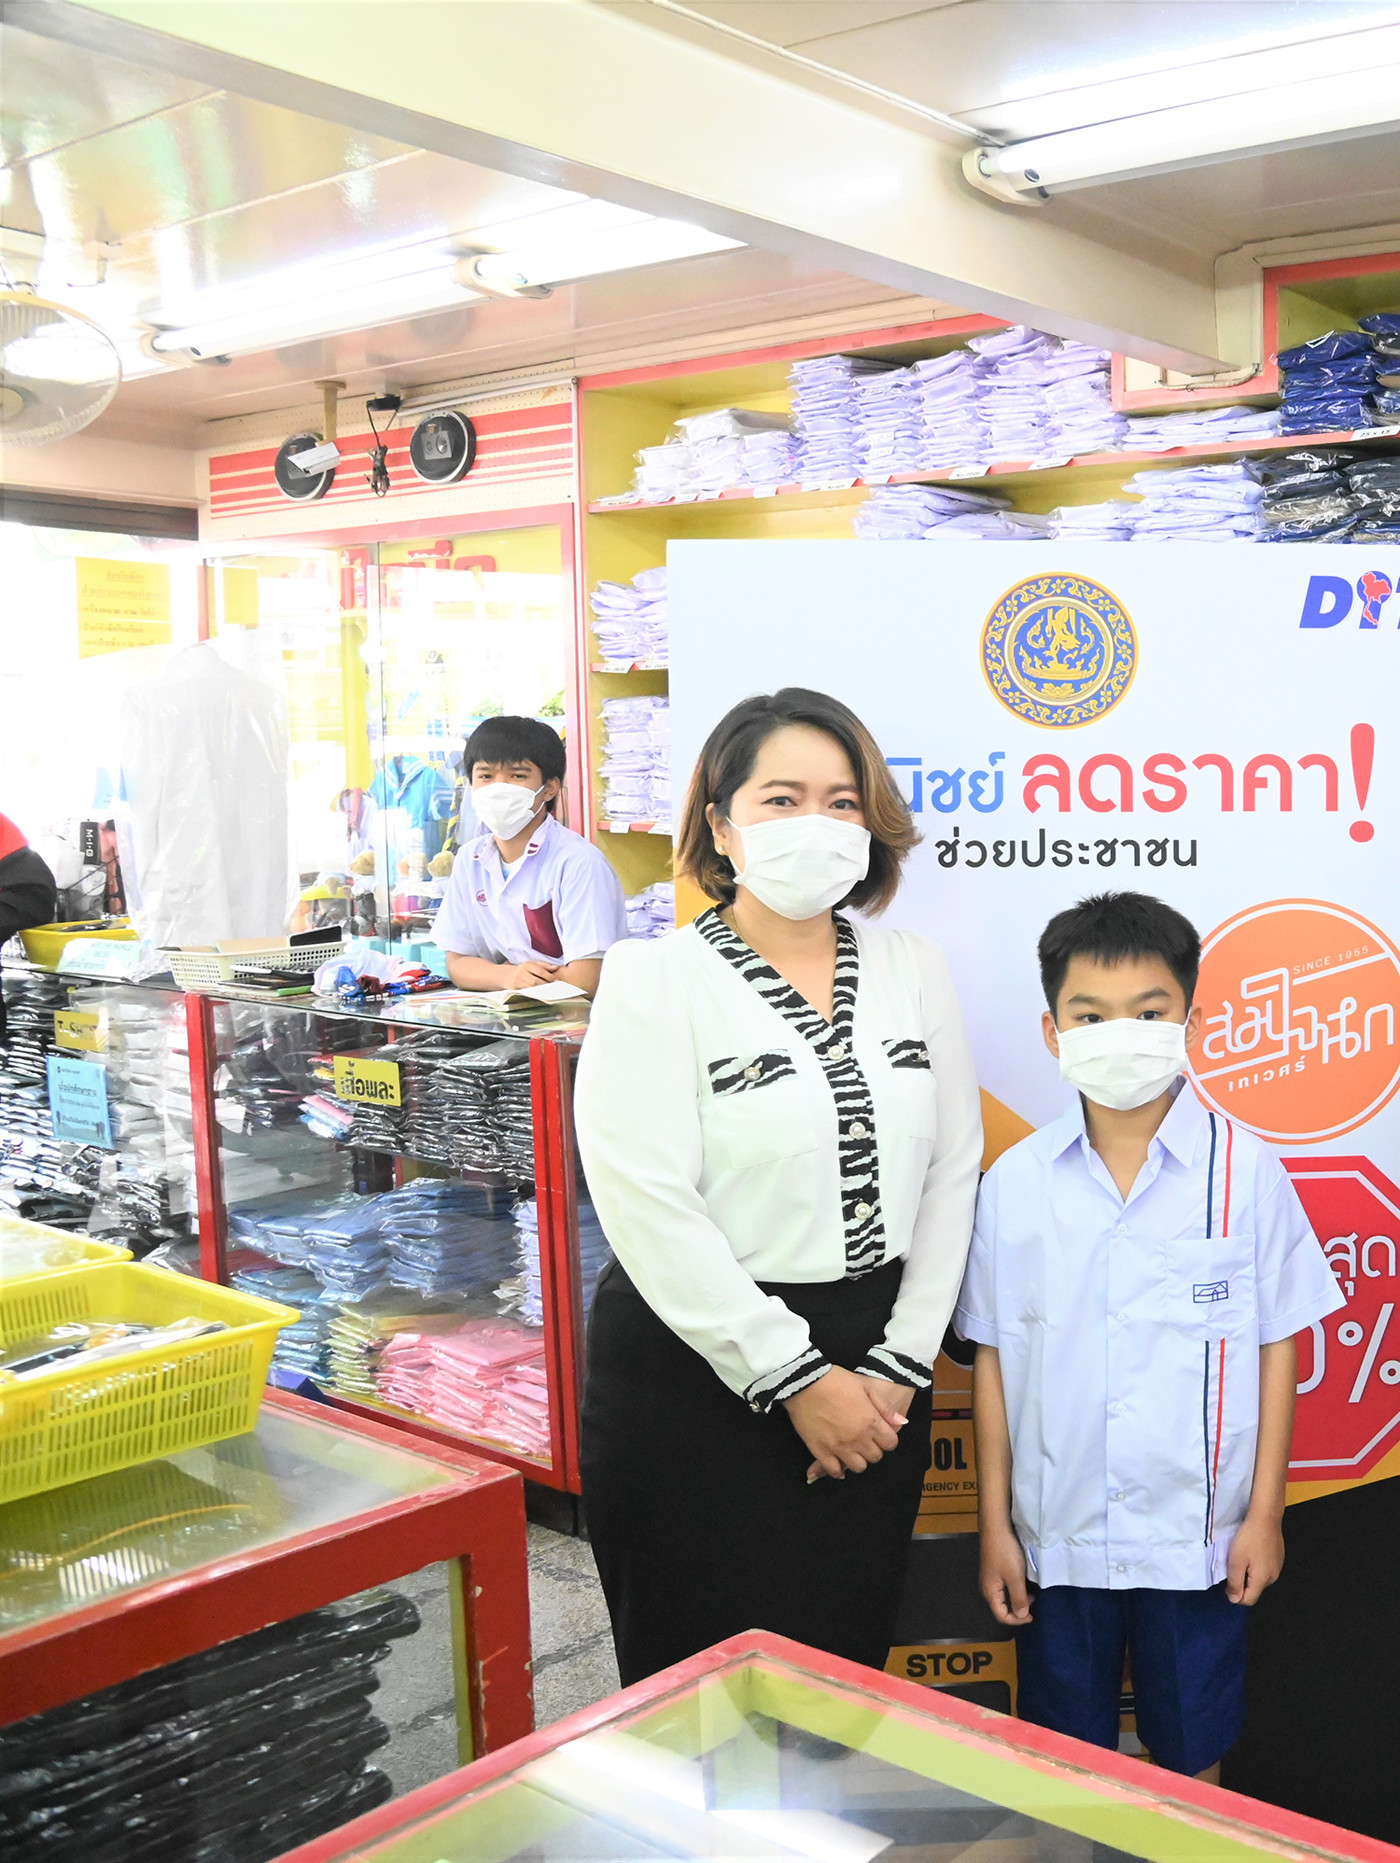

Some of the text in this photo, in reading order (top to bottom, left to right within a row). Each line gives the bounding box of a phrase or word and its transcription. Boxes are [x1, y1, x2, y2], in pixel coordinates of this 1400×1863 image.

[1022, 722, 1376, 843] ลดราคา!
[934, 826, 1199, 869] ช่วยประชาชน
[1293, 946, 1368, 974] SINCE 1955
[1228, 1056, 1307, 1092] เทเวศร์
[906, 1650, 993, 1678] STOP
